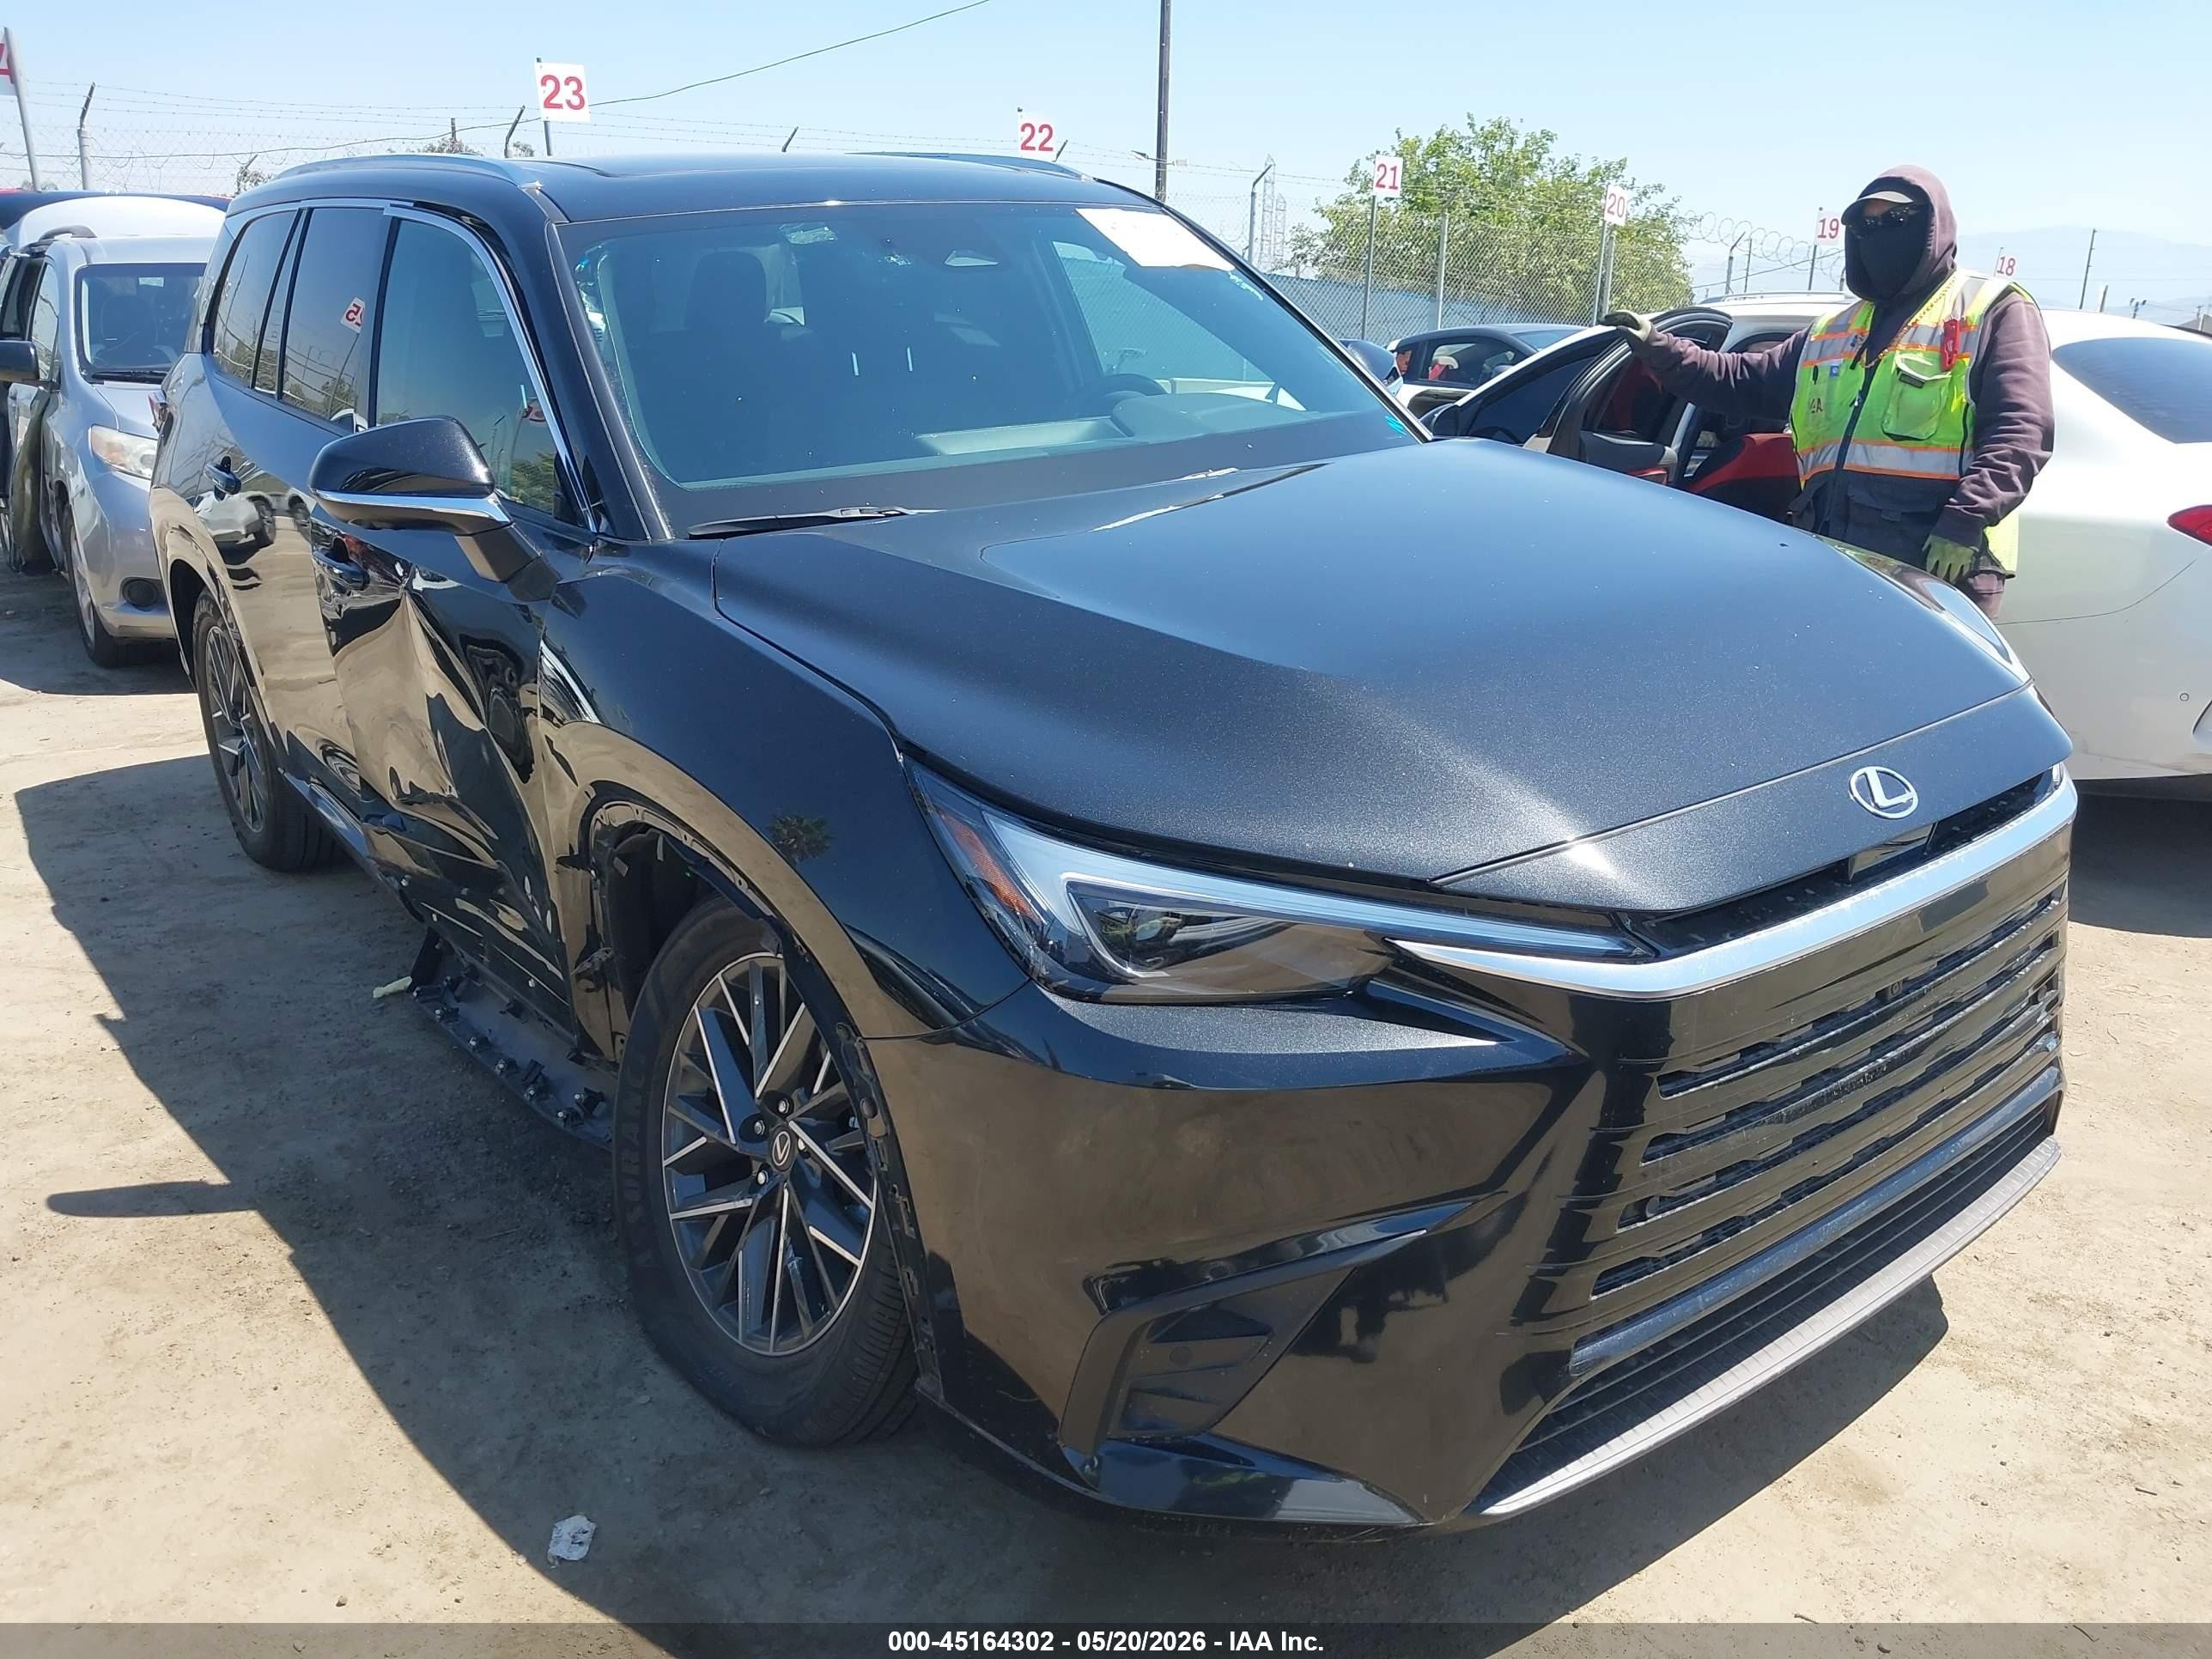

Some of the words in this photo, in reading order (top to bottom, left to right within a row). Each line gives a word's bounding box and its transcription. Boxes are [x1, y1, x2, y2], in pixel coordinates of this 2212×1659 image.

[540, 75, 585, 110] 23
[1021, 123, 1053, 151] 22
[1376, 163, 1398, 189] 21
[1607, 192, 1625, 218] 20
[1817, 218, 1839, 239] 19
[1996, 256, 2015, 276] 18
